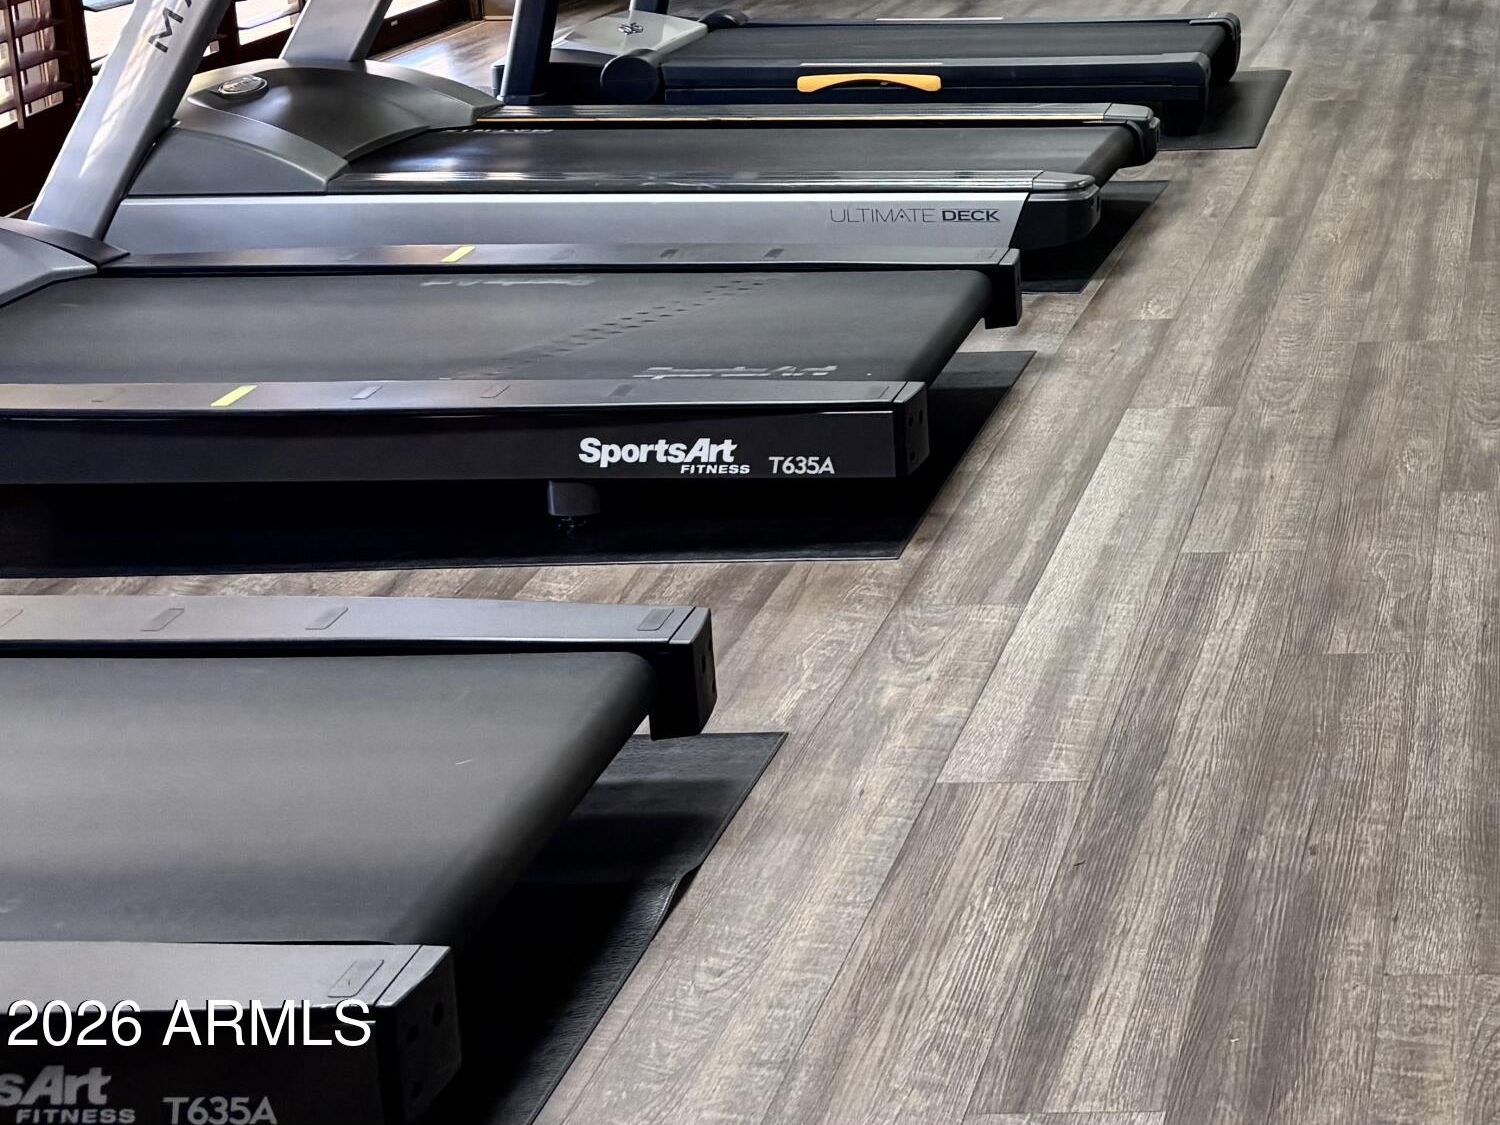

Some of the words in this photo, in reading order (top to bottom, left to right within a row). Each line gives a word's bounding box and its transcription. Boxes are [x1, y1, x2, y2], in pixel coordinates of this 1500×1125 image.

[829, 208, 937, 223] ULTIMATE
[941, 209, 1001, 222] DECK
[578, 437, 738, 468] SportsArt
[680, 464, 750, 474] FITNESS
[768, 456, 835, 474] T635A
[16, 1108, 136, 1124] FITNESS
[162, 1095, 279, 1125] T635A
